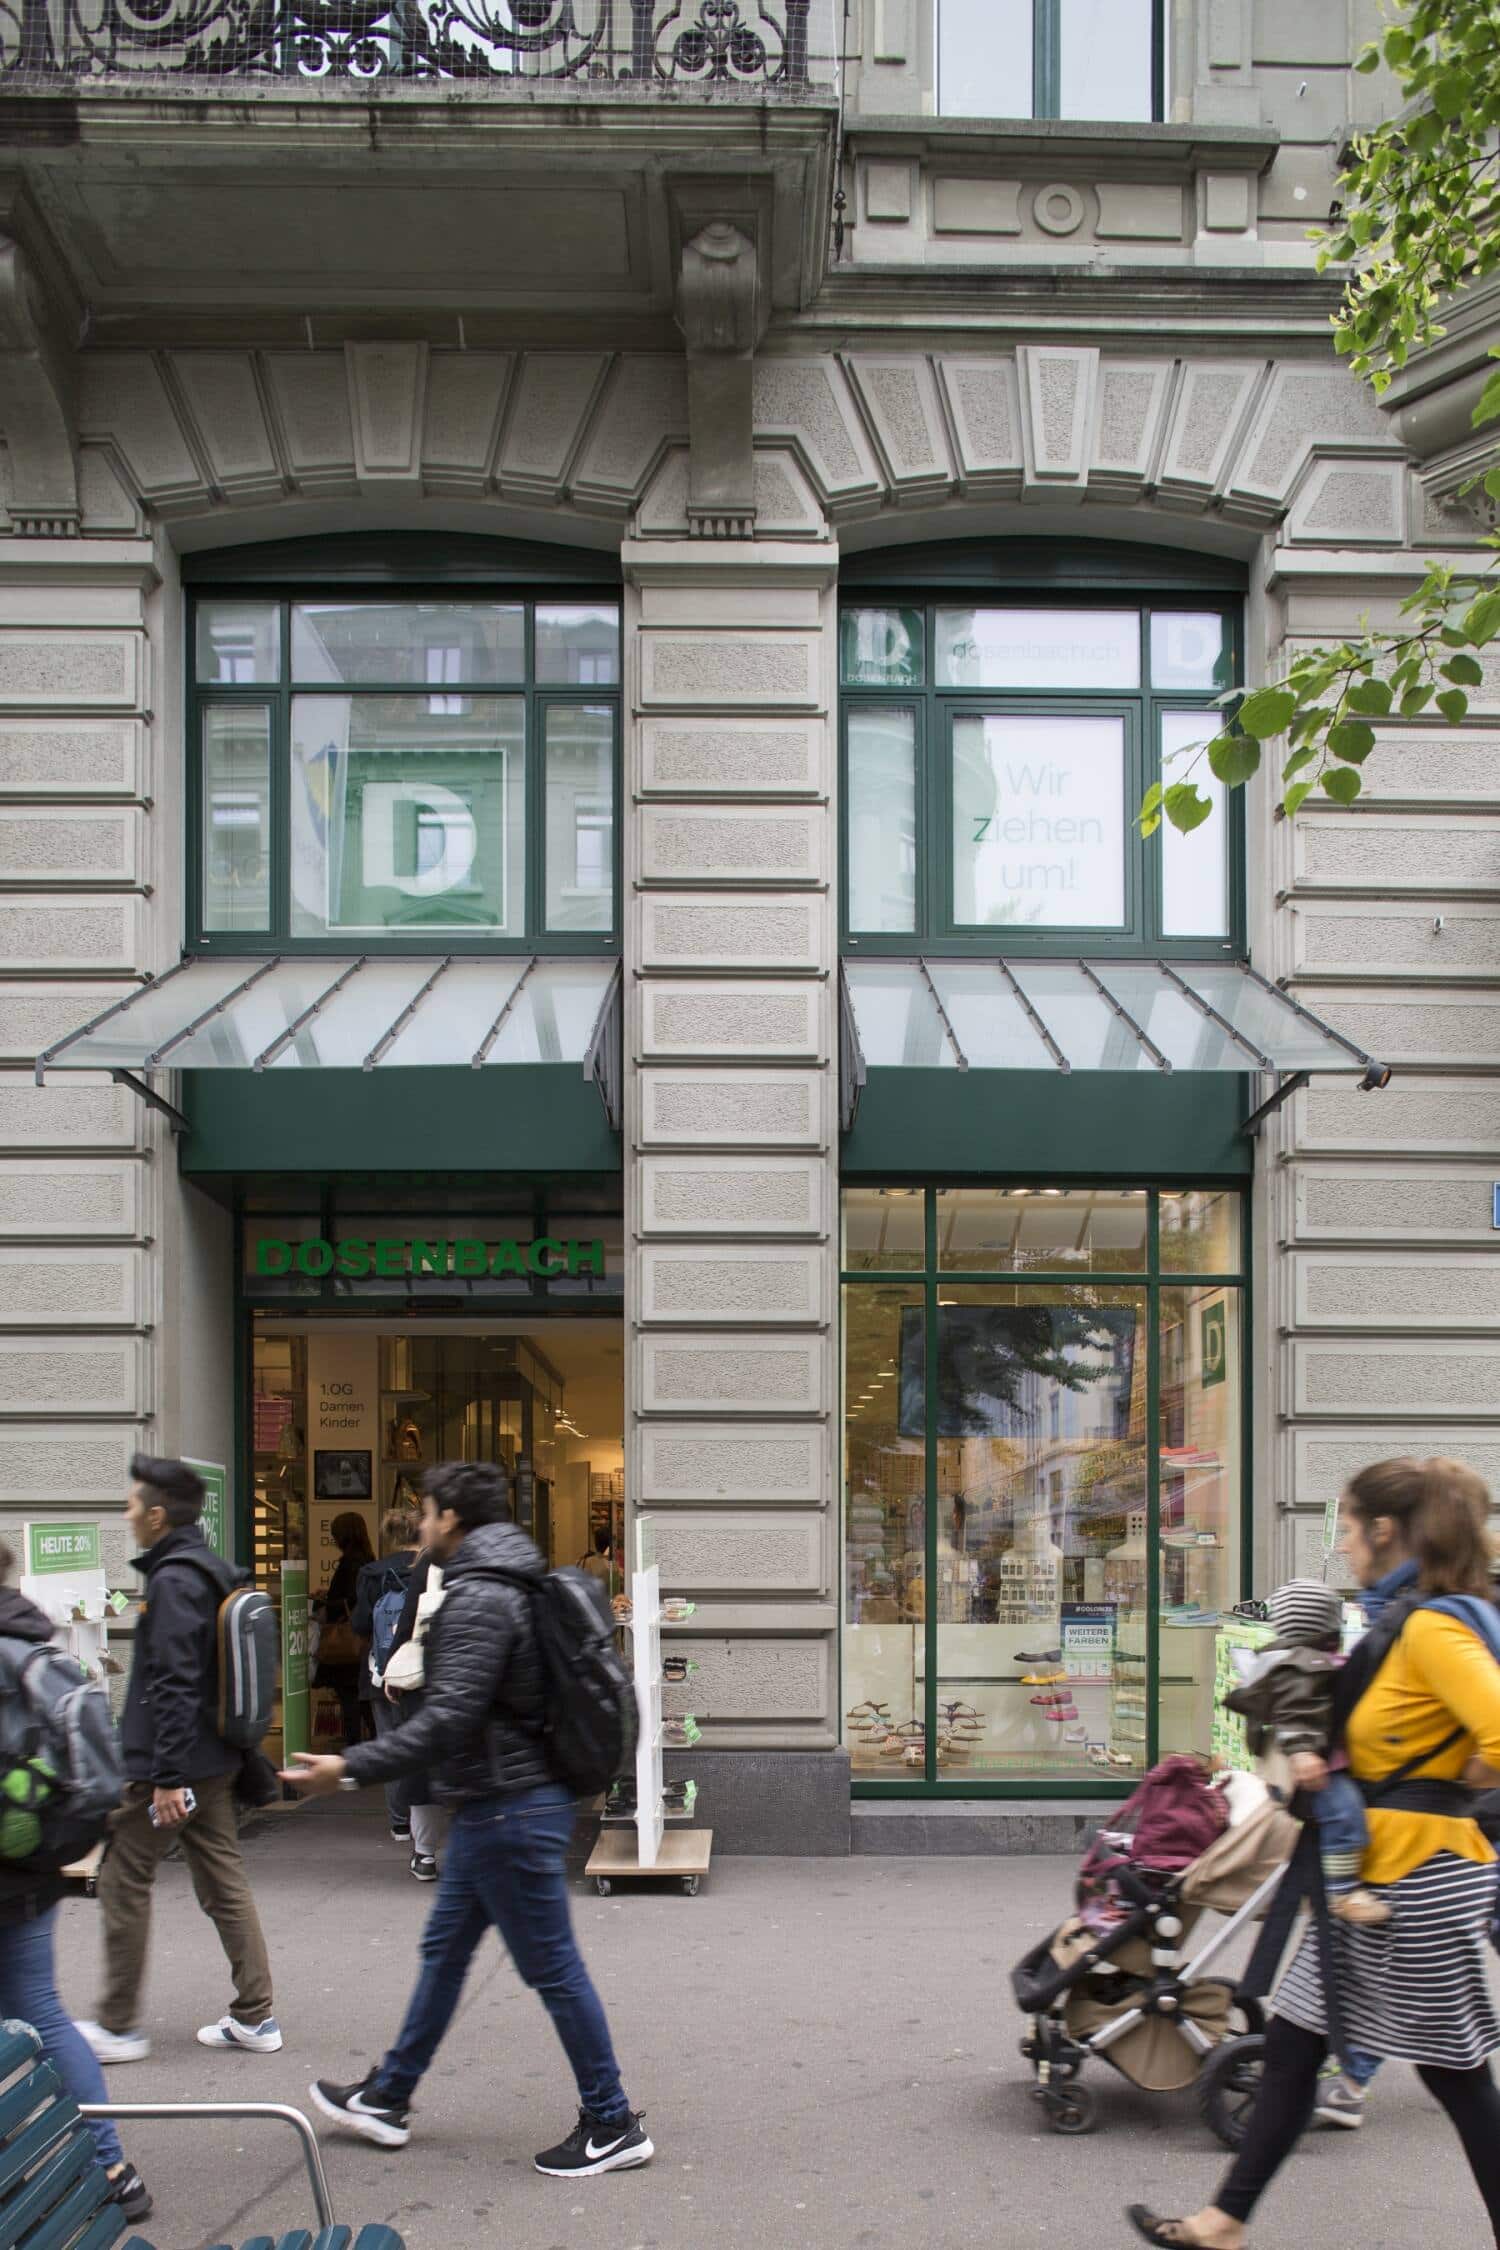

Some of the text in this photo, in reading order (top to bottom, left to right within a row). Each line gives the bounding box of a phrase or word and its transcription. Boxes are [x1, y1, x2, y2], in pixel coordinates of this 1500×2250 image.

[1005, 760, 1072, 797] Wir
[362, 781, 477, 898] D
[972, 808, 1103, 844] ziehen
[1001, 856, 1075, 892] um!
[255, 1238, 605, 1278] DOSENBACH
[1205, 1322, 1222, 1369] D
[320, 1401, 365, 1412] Damen
[320, 1416, 361, 1428] Kinder
[40, 1535, 92, 1554] HEUTE 20%
[1069, 1628, 1109, 1636] WEITERE
[1069, 1637, 1109, 1645] FARBEN
